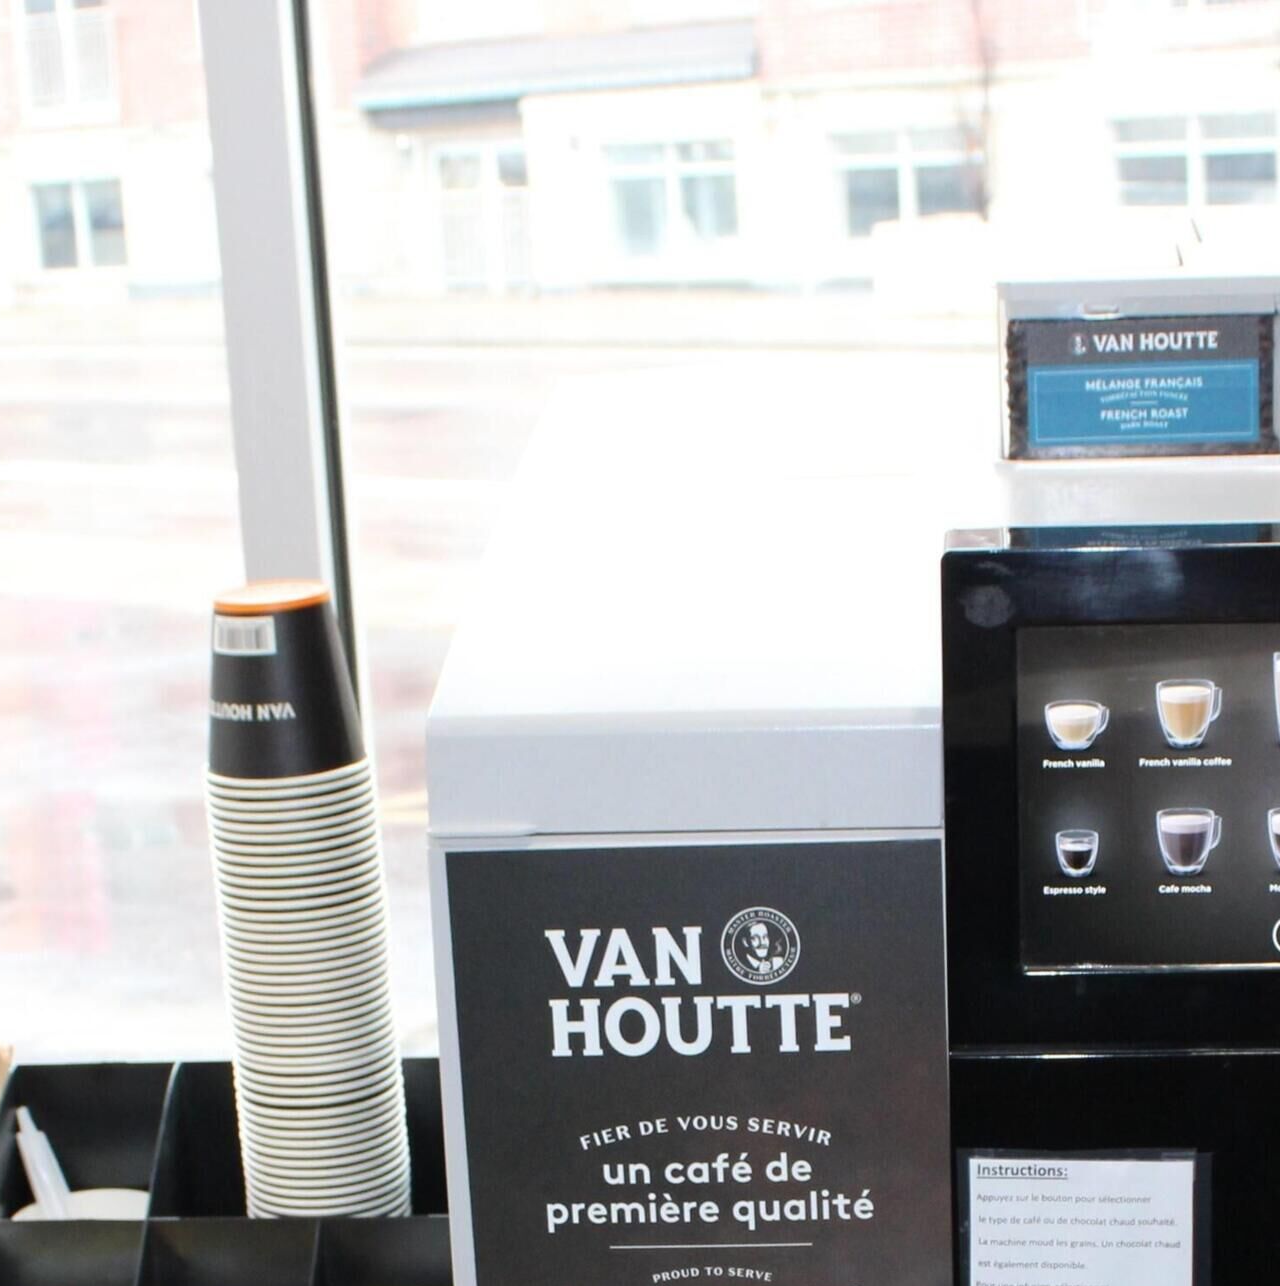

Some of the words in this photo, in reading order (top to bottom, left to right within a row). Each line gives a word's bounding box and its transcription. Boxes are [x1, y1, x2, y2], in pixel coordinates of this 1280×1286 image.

[1093, 334, 1133, 352] VAN
[1140, 331, 1218, 350] HOUTTE
[1085, 378, 1141, 391] MÉLANGE
[1144, 376, 1203, 390] FRANÇAIS
[1100, 409, 1147, 421] FRENCH
[1151, 408, 1188, 419] ROAST
[257, 702, 296, 720] VAN
[1043, 759, 1074, 768] French
[1076, 759, 1105, 768] vanilla
[1139, 758, 1170, 767] French
[1172, 758, 1201, 766] vanilla
[1203, 757, 1232, 766] coffee
[1043, 886, 1083, 896] Espresso
[1085, 885, 1106, 895] style
[1181, 885, 1211, 893] mocha
[545, 927, 702, 987] VAN
[548, 993, 851, 1056] HOUTTE
[580, 1125, 631, 1150] FIER
[639, 1118, 669, 1136] DE
[677, 1115, 738, 1131] VOUS
[747, 1117, 831, 1145] SERVIR
[603, 1162, 650, 1184] un
[664, 1153, 752, 1184] café
[766, 1152, 812, 1181] de
[977, 1164, 1068, 1177] Instructions:
[547, 1192, 719, 1233] première
[733, 1189, 874, 1230] qualité
[652, 1268, 700, 1283] PROUD
[706, 1267, 723, 1276] TO
[728, 1267, 772, 1282] SERVE
